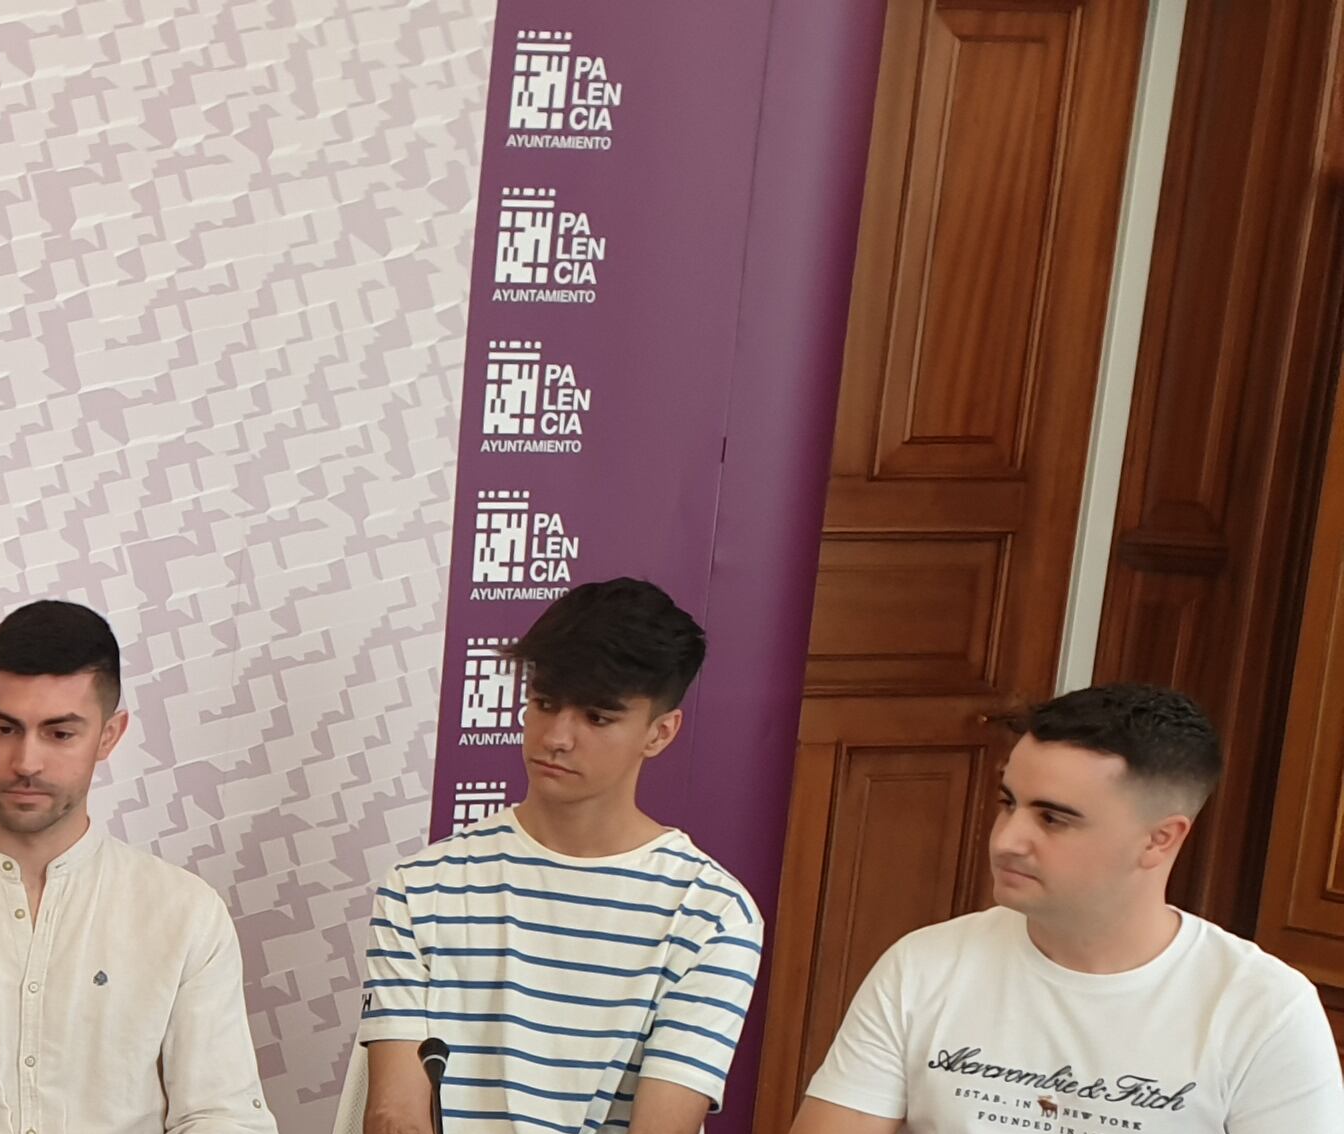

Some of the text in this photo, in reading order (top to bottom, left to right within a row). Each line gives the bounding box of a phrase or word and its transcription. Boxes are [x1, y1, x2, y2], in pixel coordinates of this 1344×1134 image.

[574, 57, 607, 80] PA
[571, 82, 622, 106] LEN
[569, 108, 612, 131] CIA
[506, 134, 611, 150] AYUNTAMIENTO
[559, 212, 591, 235] PA
[556, 237, 606, 261] LEN
[553, 262, 597, 285] CIA
[492, 289, 596, 304] AYUNTAMIENTO
[544, 364, 576, 387] PA
[542, 388, 591, 411] LEN
[540, 412, 583, 435] CIA
[480, 439, 582, 453] AYUNTAMIENTO
[532, 513, 565, 535] PA
[532, 537, 579, 560] LEN
[529, 560, 571, 583] CIA
[458, 732, 524, 746] AYUNTAMI
[928, 1046, 1196, 1112] Abercrombie & Fitch
[954, 1088, 1143, 1131] ESTAB. IN NEW YORK
[977, 1111, 1052, 1132] FOUNDED
